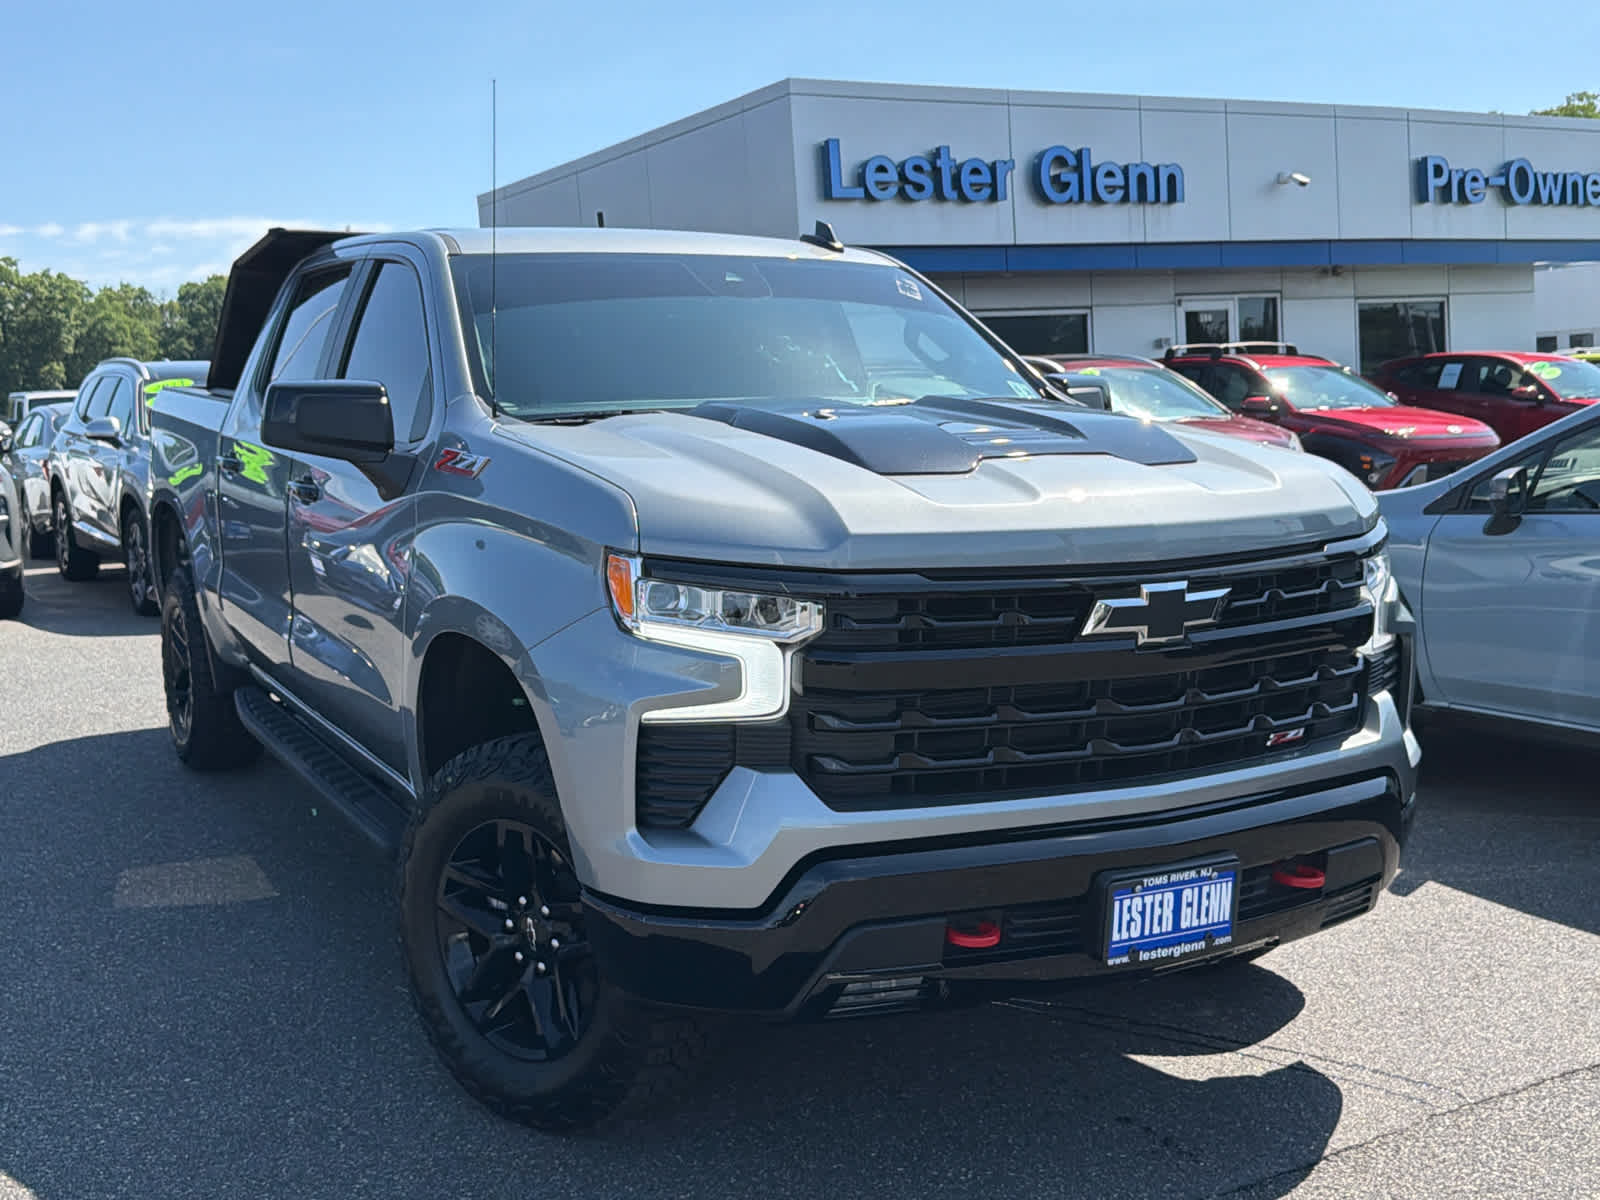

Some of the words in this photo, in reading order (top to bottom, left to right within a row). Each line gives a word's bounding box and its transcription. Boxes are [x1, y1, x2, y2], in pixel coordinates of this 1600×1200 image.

[822, 138, 1015, 201] Lester
[1034, 145, 1185, 203] Glenn
[434, 447, 491, 480] Z71
[1143, 874, 1168, 887] TOMS
[1200, 867, 1212, 877] NJ
[1112, 891, 1174, 941] LESTER
[1180, 881, 1232, 929] GLENN
